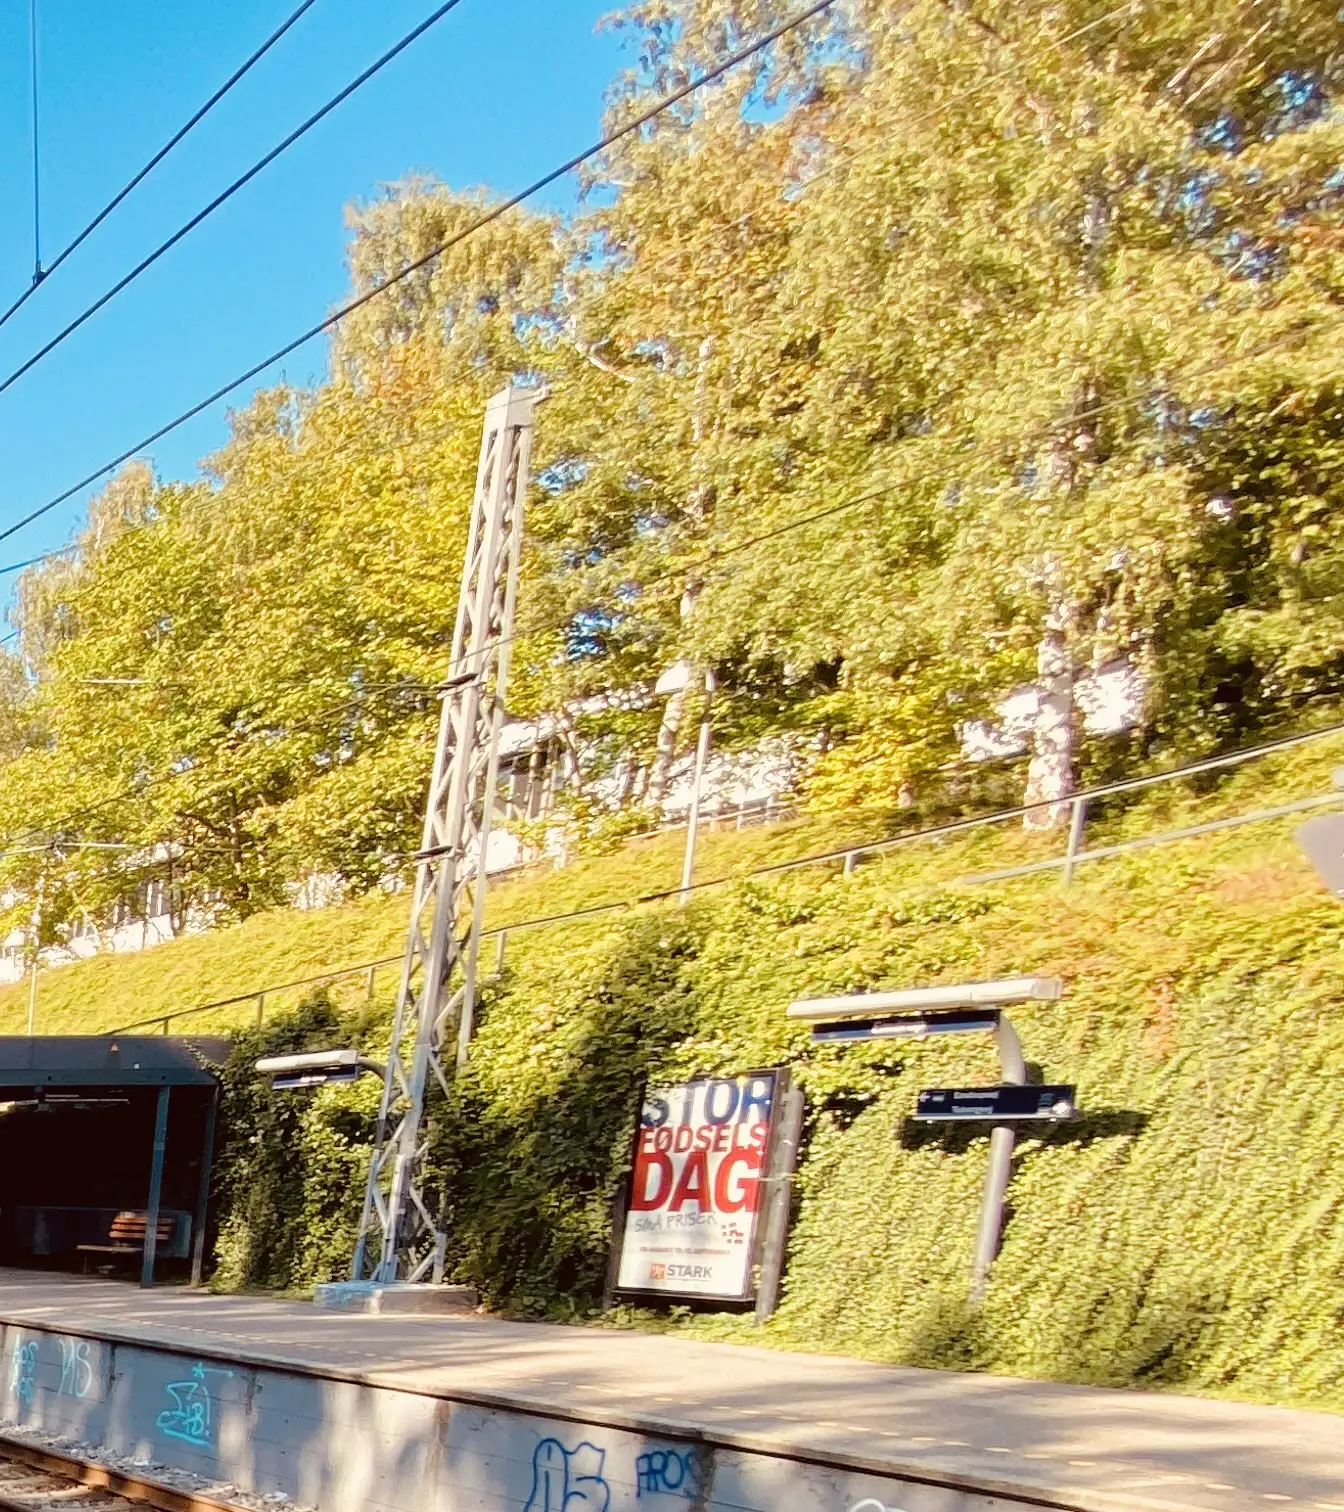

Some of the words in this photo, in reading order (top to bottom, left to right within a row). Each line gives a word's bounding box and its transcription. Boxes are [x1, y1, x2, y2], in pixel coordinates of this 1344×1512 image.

[641, 1076, 774, 1128] STOR
[639, 1121, 770, 1154] FØDSELS
[631, 1150, 764, 1214] DAG
[667, 1264, 713, 1278] STARK
